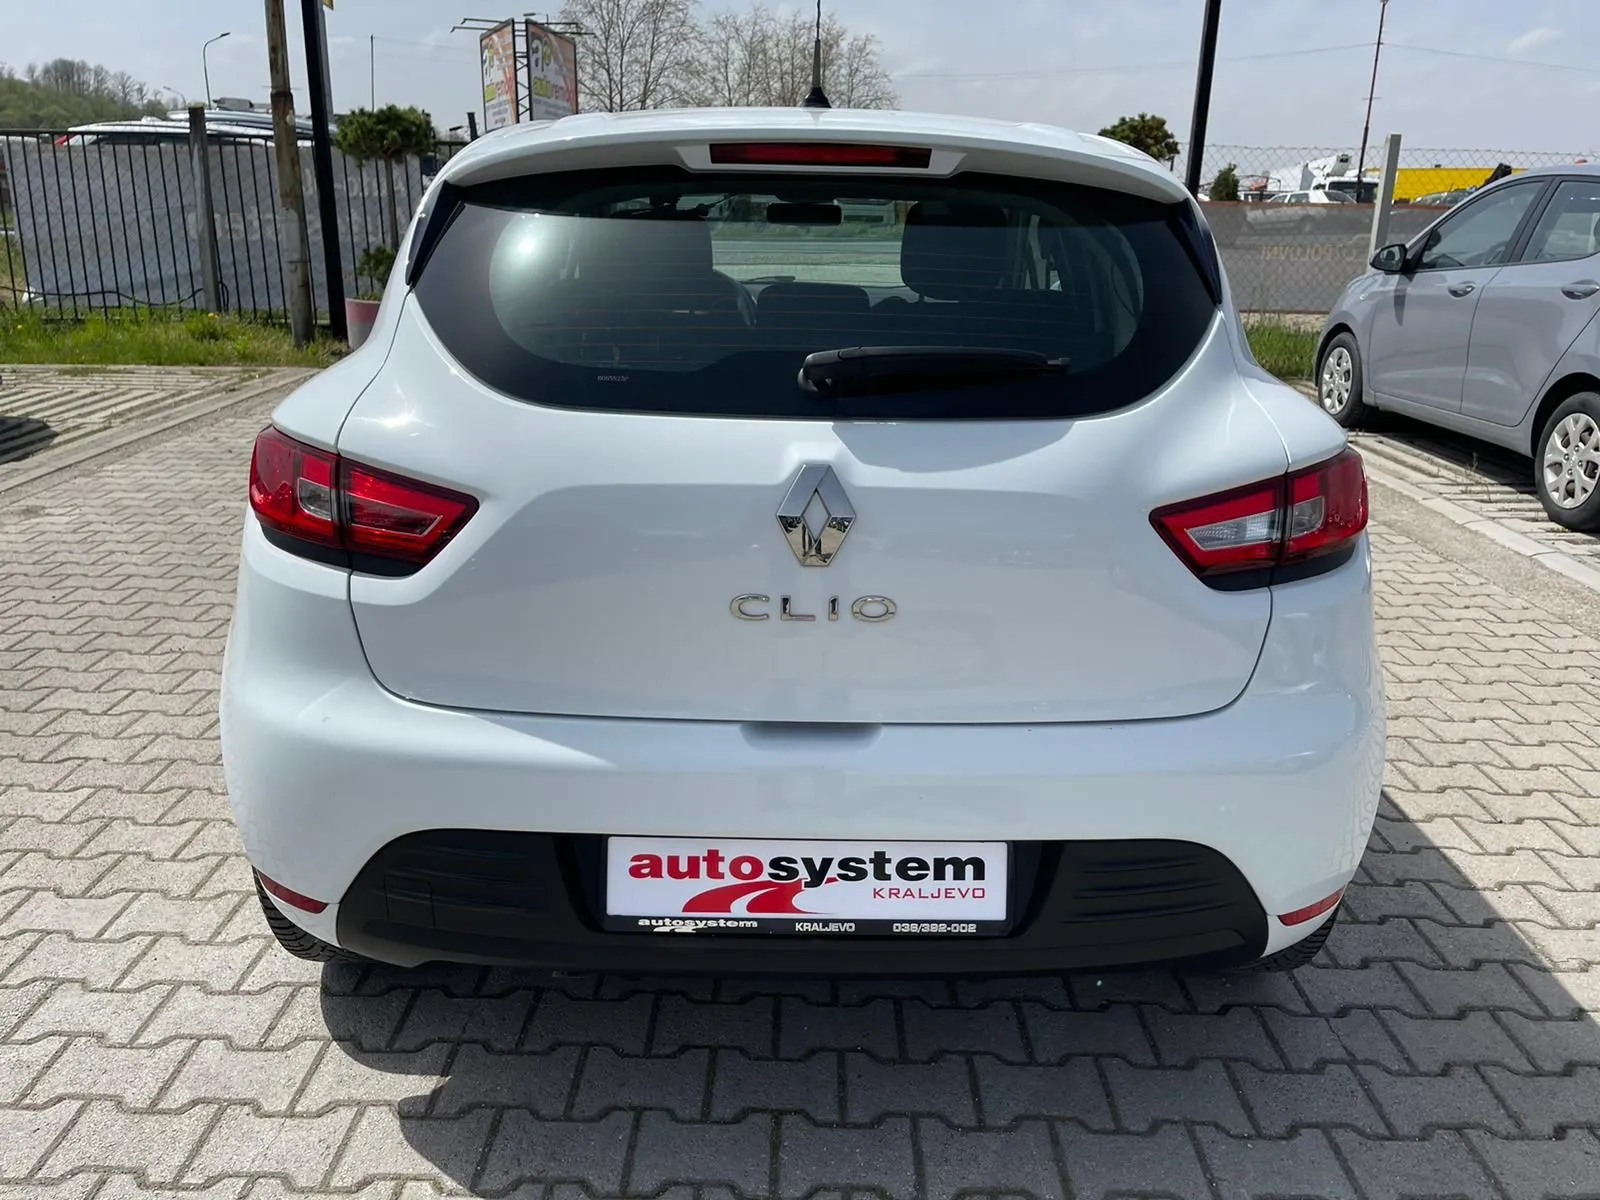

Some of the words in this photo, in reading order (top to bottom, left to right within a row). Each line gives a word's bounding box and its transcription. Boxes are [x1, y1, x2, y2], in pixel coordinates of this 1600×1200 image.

[730, 593, 897, 622] CLIO
[628, 849, 986, 889] autosystem
[873, 887, 986, 899] KRALJEVO
[638, 918, 759, 929] autosystem
[795, 922, 856, 932] KRALJEVO
